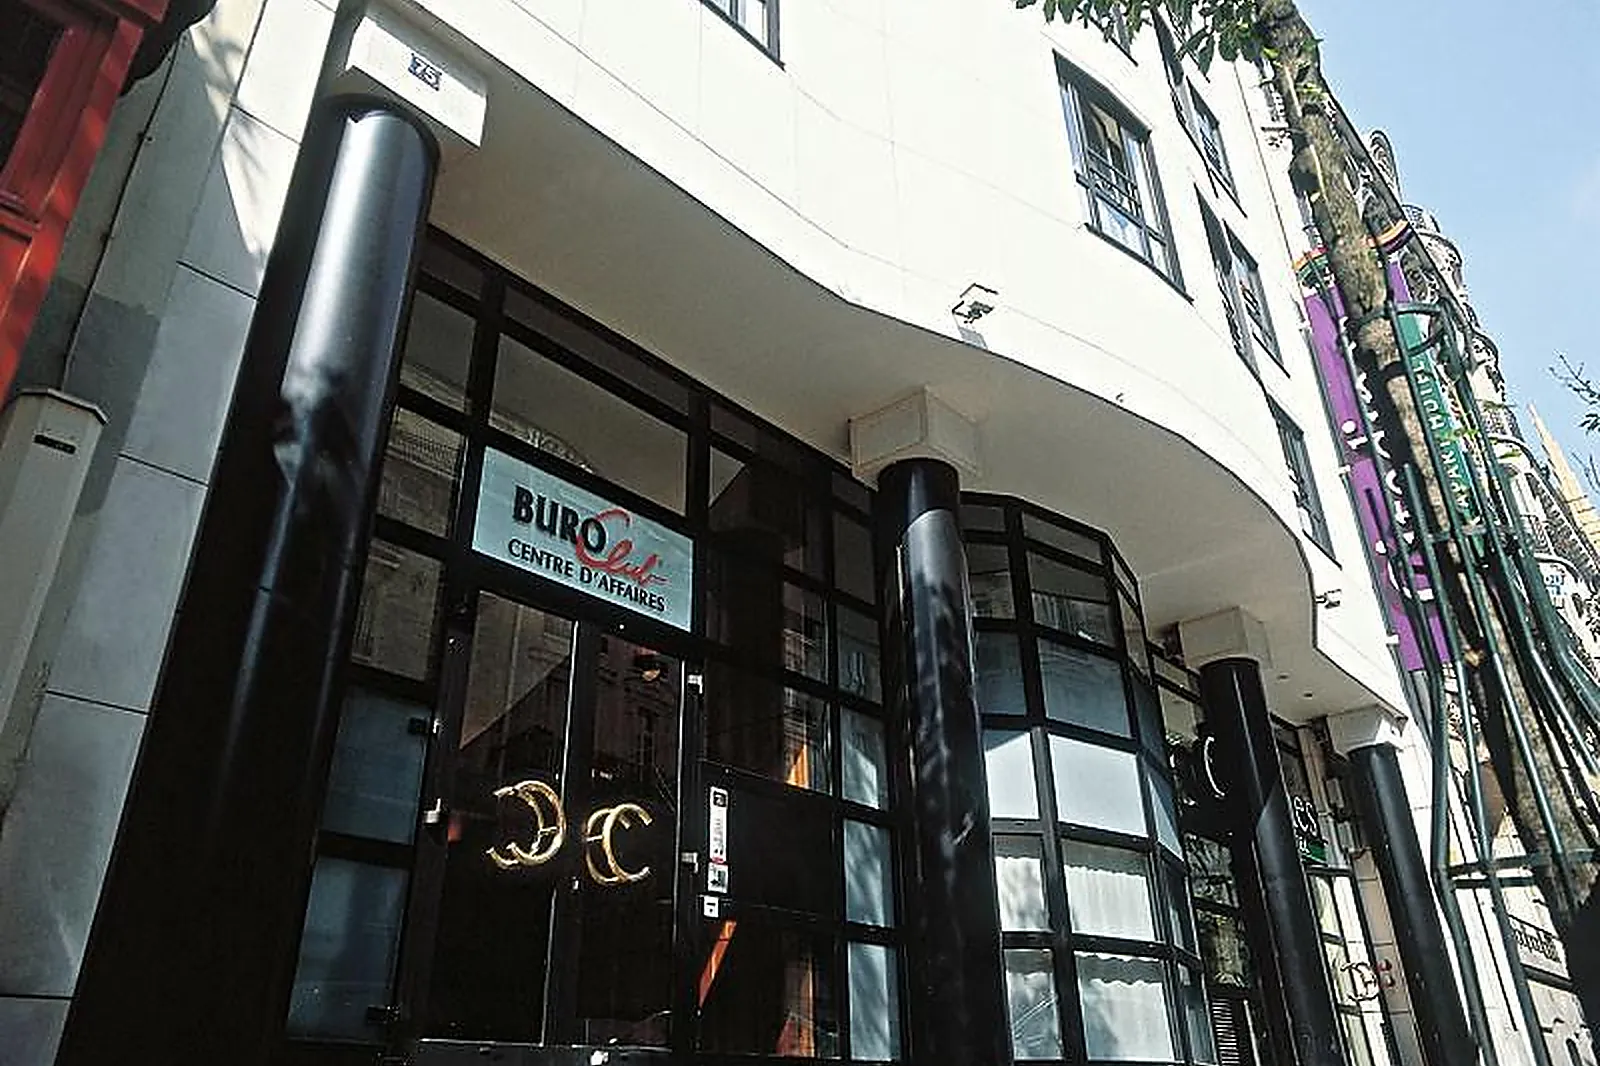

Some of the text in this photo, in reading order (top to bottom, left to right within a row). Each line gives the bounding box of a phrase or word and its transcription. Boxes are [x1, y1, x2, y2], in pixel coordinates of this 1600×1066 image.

[508, 538, 666, 612] CENTRE D'AFFAIRES
[512, 485, 671, 585] BURO Club
